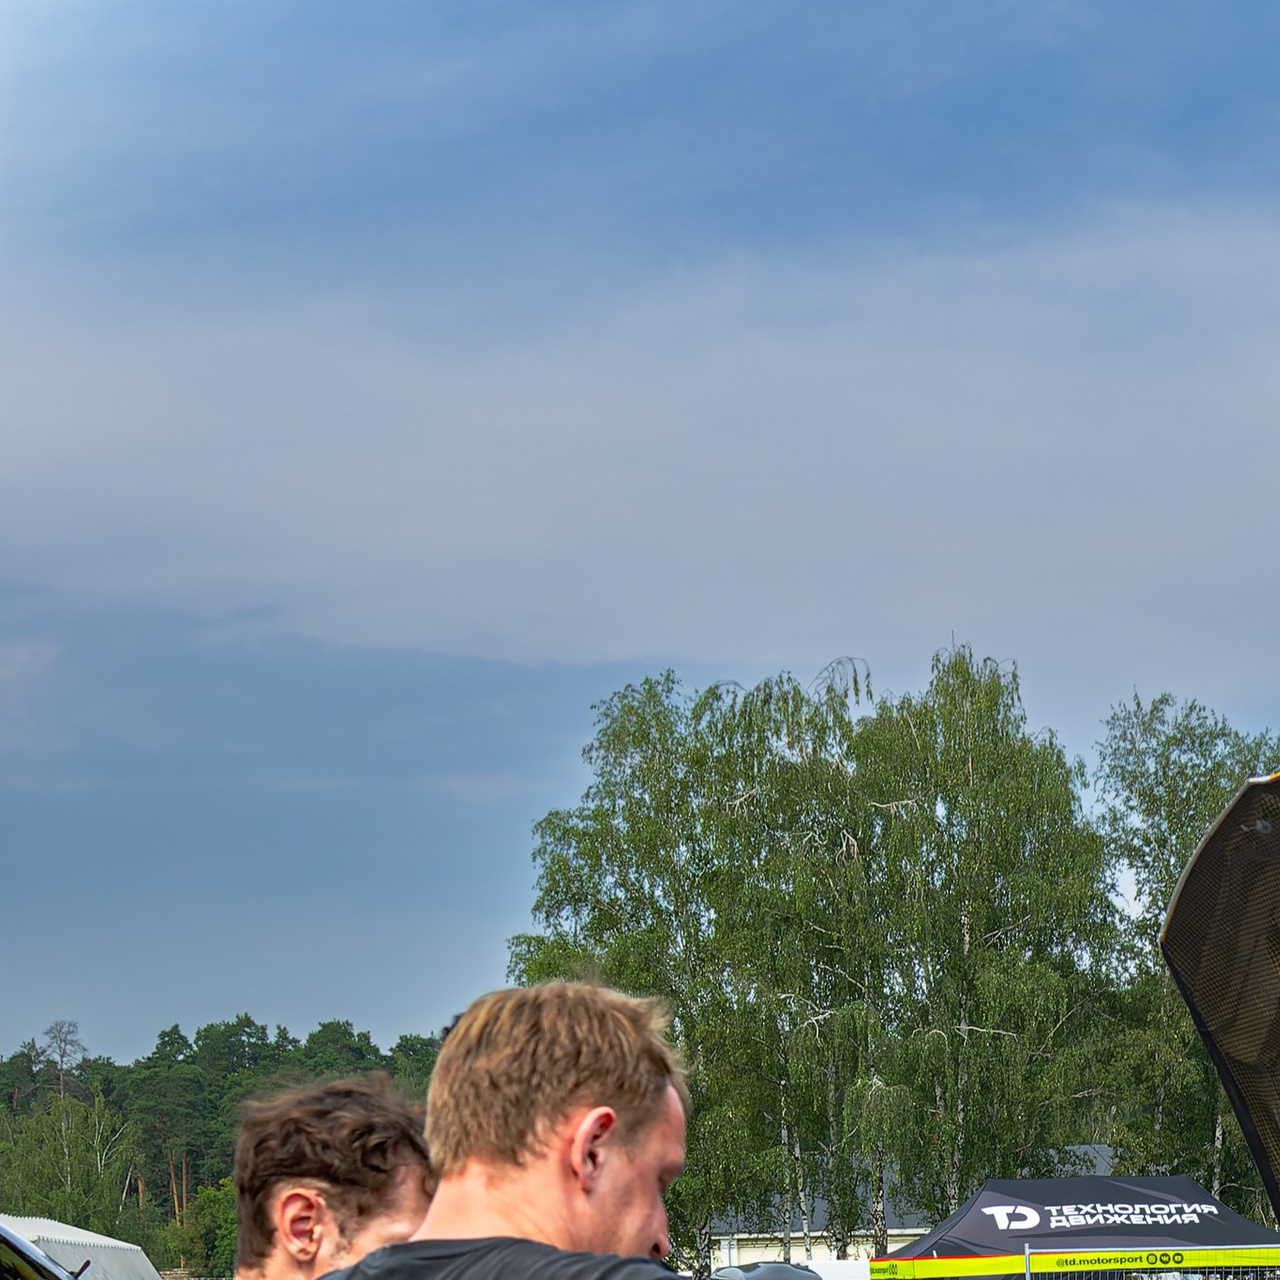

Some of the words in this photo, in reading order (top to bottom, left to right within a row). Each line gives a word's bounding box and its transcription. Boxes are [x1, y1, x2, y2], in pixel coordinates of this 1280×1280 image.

[1044, 1203, 1219, 1216] ТЕХНОЛОГИЯ
[1050, 1213, 1200, 1228] ДВИЖЕНИЯ
[1056, 1255, 1143, 1267] @td.motorsport
